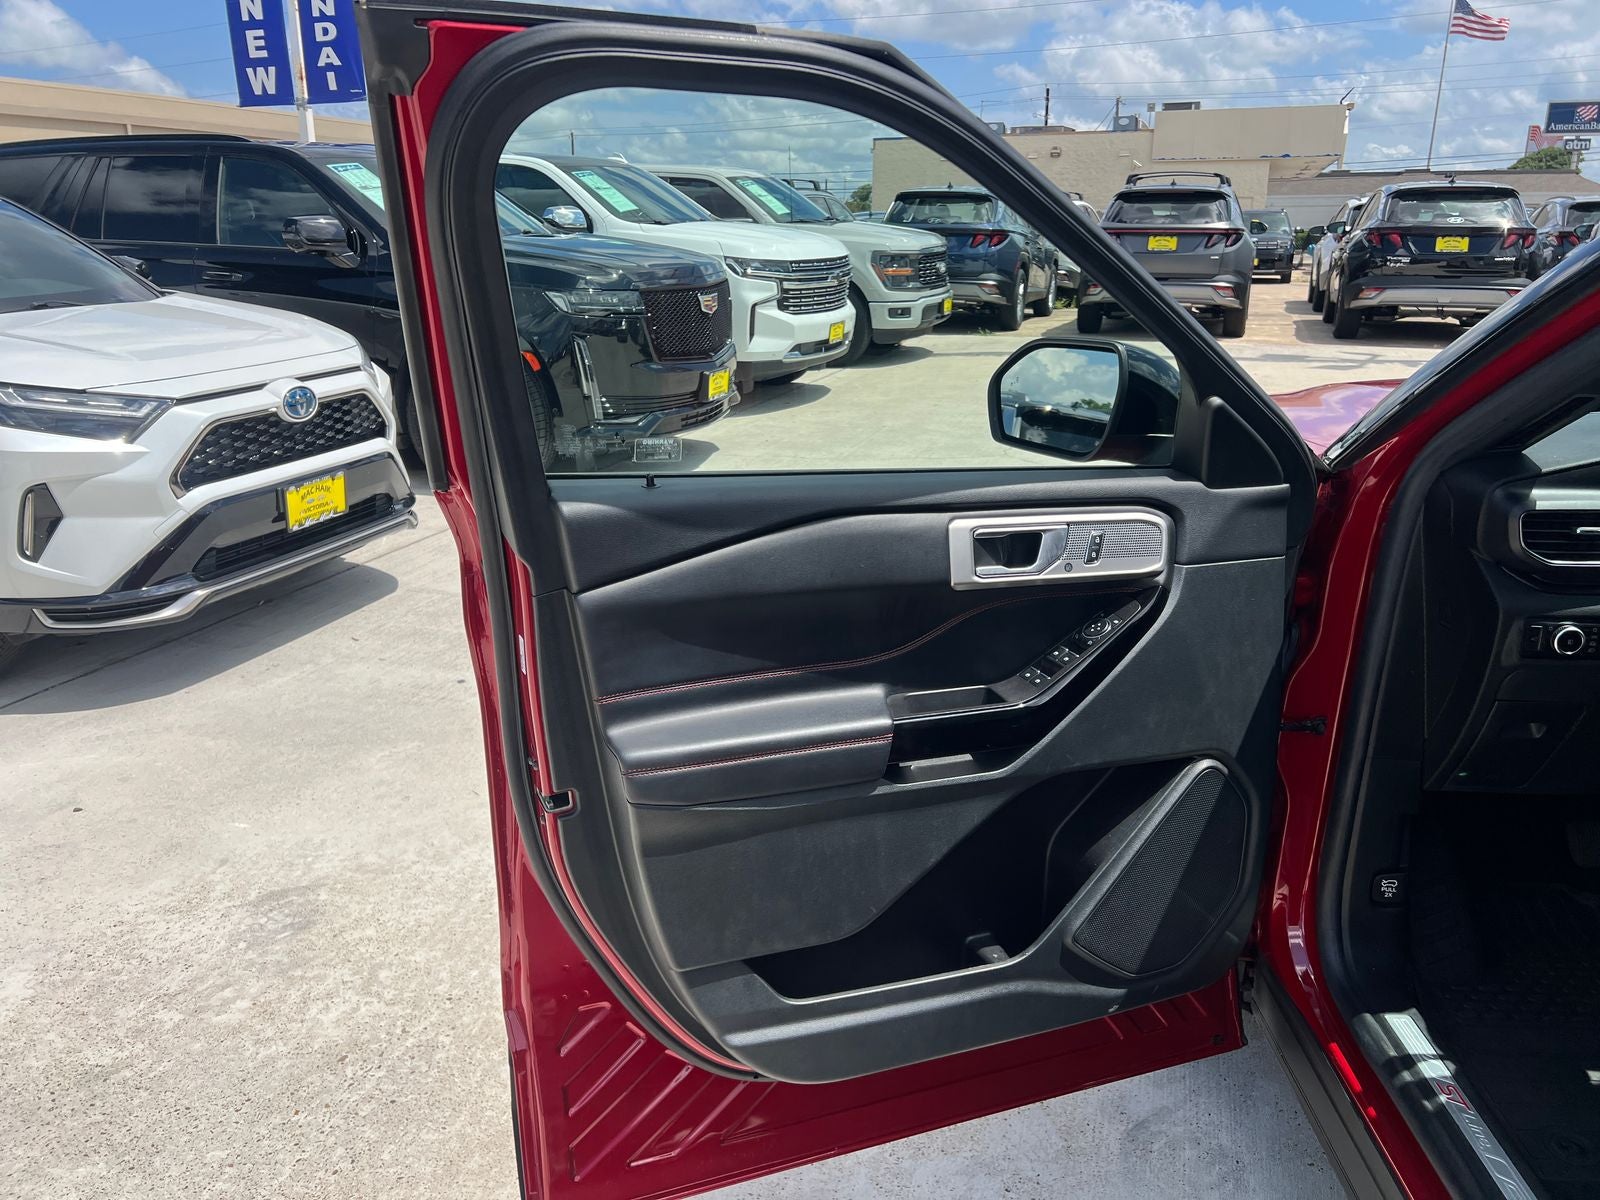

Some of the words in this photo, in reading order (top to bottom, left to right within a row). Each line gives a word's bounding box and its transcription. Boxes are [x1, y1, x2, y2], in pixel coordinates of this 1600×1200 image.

[239, 0, 276, 95] NEW
[1566, 140, 1590, 149] atm
[301, 486, 314, 500] MAC
[315, 484, 331, 493] HAIK
